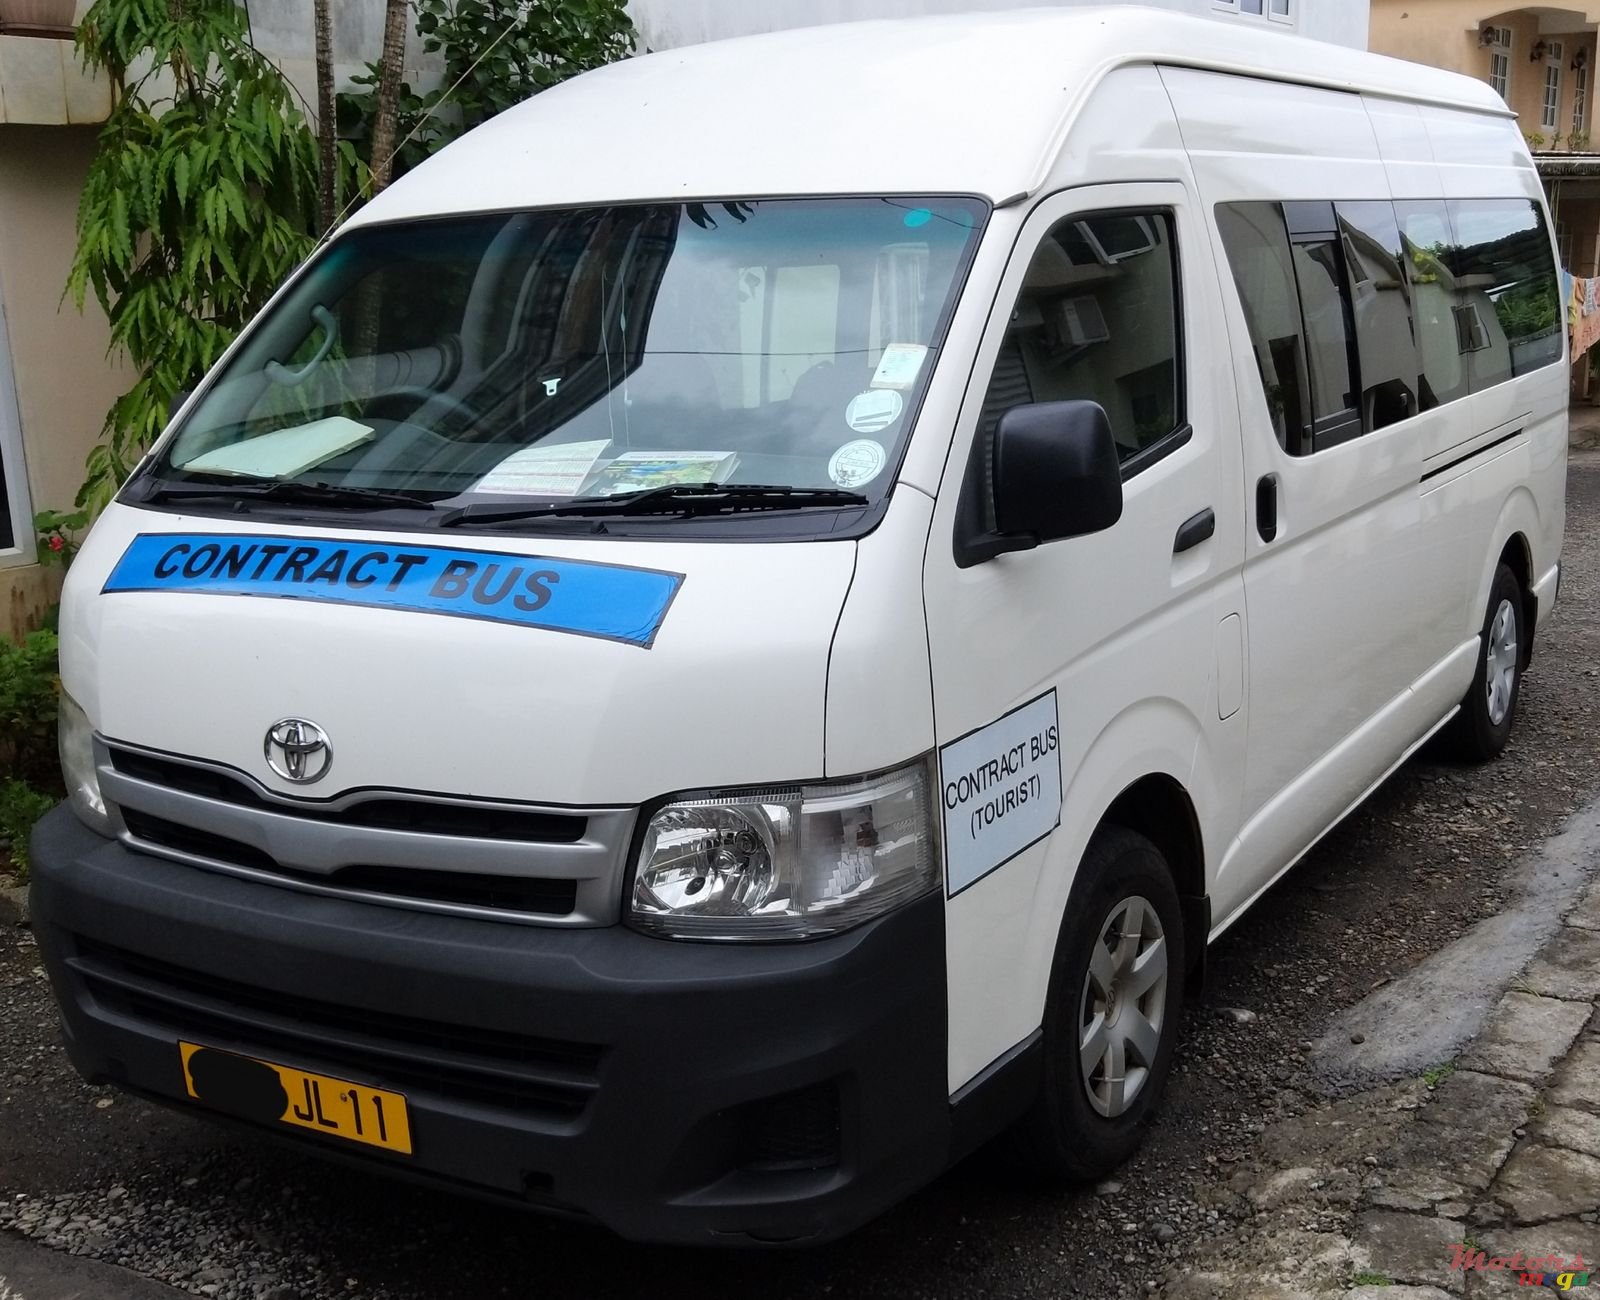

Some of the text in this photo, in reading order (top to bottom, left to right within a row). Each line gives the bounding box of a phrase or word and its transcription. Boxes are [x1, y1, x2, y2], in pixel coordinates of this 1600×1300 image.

[154, 543, 559, 611] CONTRACT BUS
[945, 725, 1057, 809] CONTRACT BUS
[971, 774, 1041, 839] (TOURIST)
[293, 1078, 387, 1141] JL 11
